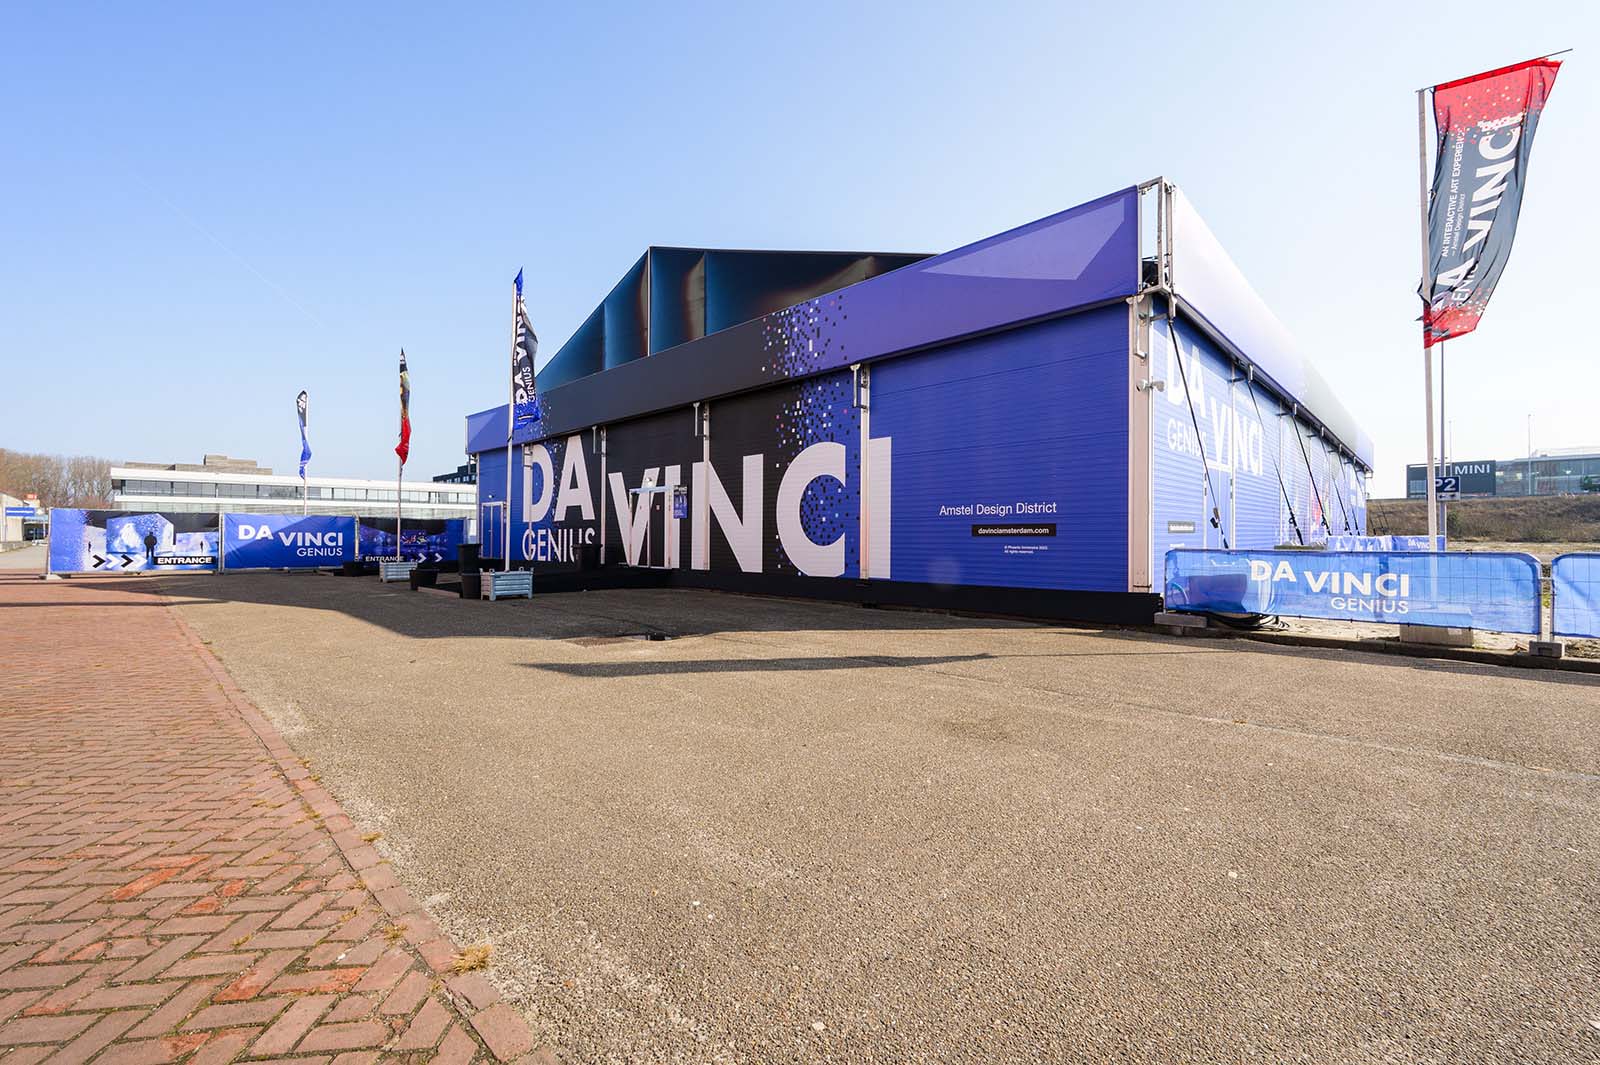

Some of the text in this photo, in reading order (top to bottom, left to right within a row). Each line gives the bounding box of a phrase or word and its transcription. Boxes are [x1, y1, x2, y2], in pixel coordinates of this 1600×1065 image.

[1450, 178, 1460, 194] ART
[1443, 194, 1458, 245] INTERACTIVE
[1442, 245, 1450, 257] AN
[1455, 464, 1490, 475] MINI
[522, 434, 892, 579] DA VINCI
[939, 501, 1057, 517] Amstel Design District
[238, 524, 343, 546] DA VINCI
[157, 556, 212, 564] ENTRANCE
[296, 547, 343, 557] GENIUS
[1250, 559, 1410, 597] DA VINCI
[1330, 597, 1409, 614] GENIUS
